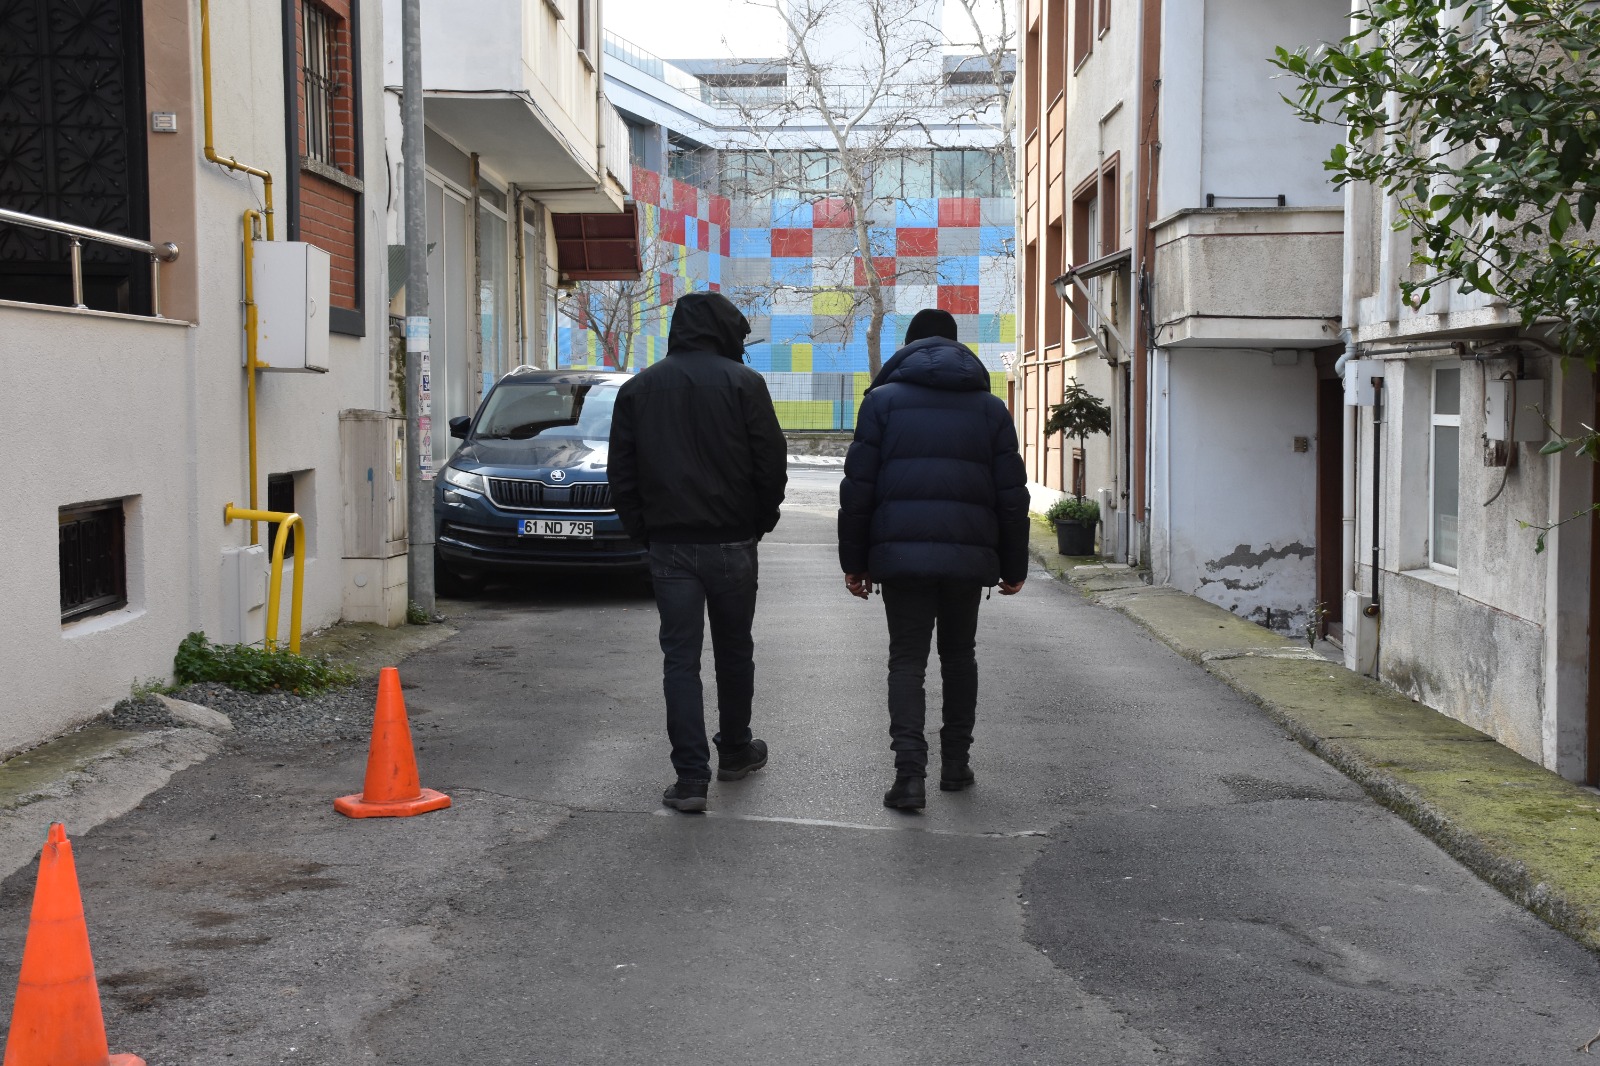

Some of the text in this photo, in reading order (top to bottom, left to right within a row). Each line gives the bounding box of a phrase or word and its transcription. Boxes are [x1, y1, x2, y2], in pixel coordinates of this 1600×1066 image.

[524, 520, 593, 535] 61 ND 795
